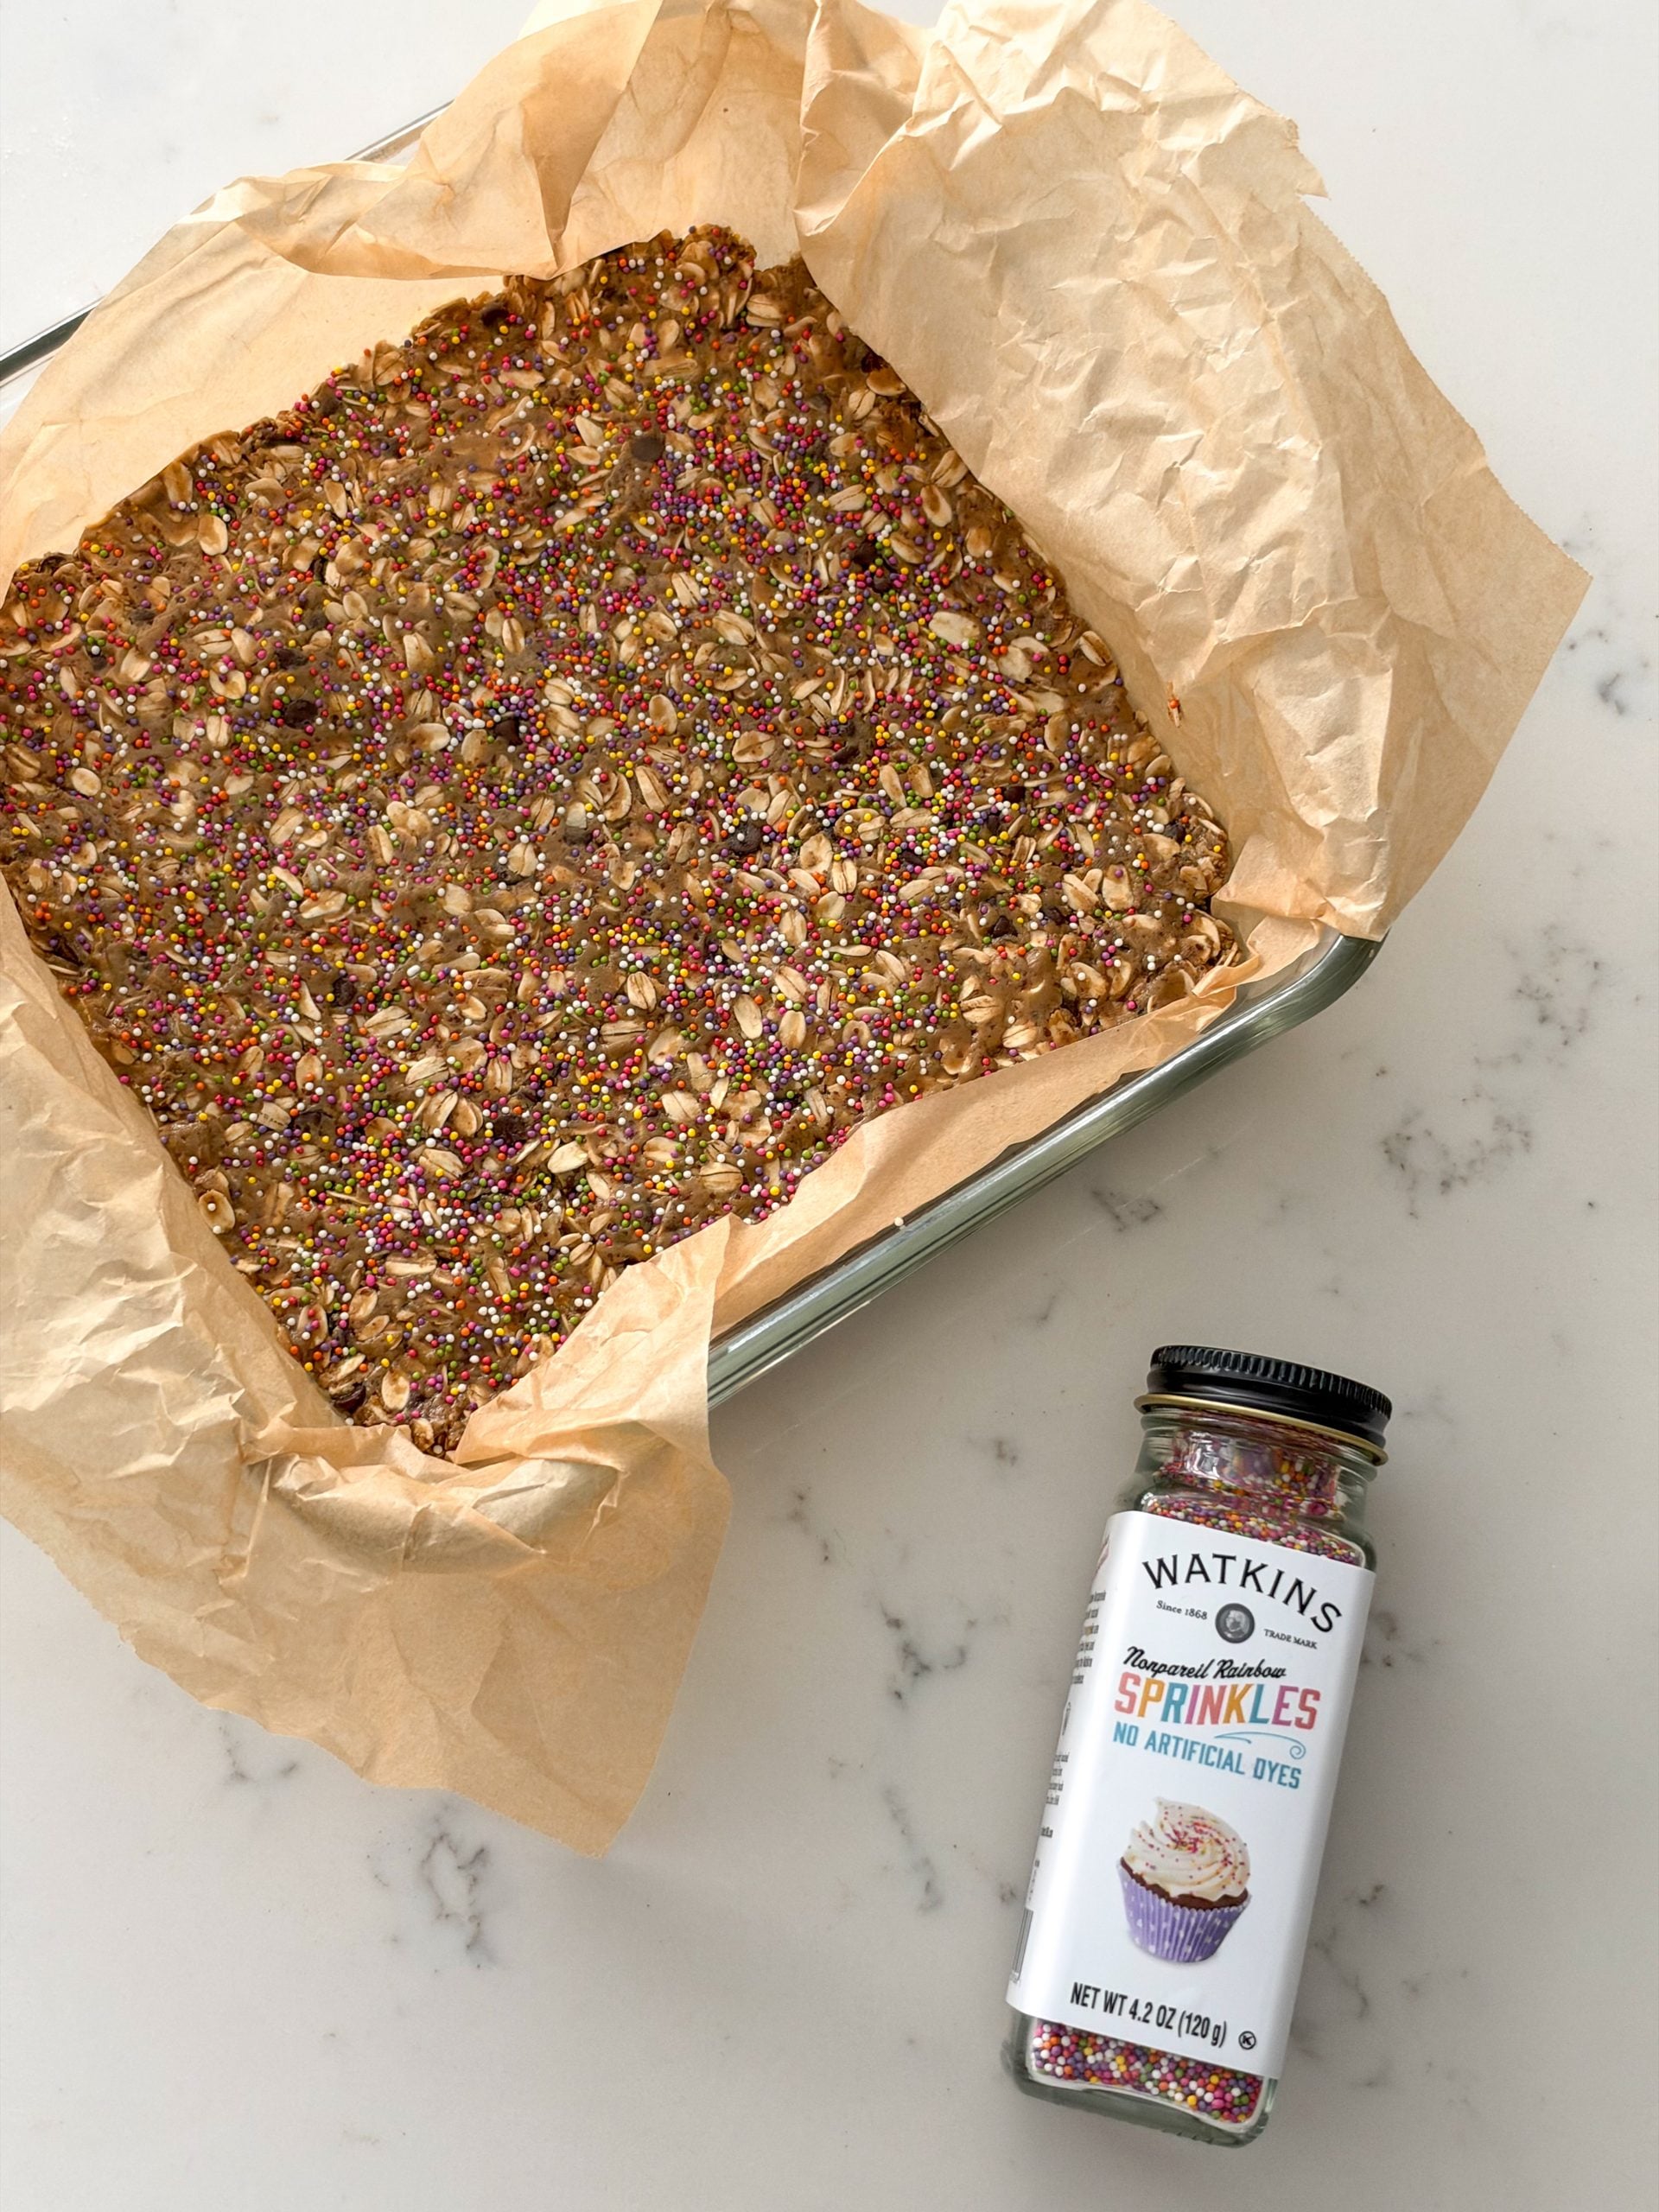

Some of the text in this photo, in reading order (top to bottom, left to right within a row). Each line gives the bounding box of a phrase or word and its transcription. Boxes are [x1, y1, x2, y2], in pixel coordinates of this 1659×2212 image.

[1142, 1553, 1342, 1633] WATKINS
[1156, 1600, 1208, 1620] Since 1868
[1123, 1646, 1215, 1679] Nonpareil
[1213, 1659, 1287, 1679] Rainbow
[1263, 1629, 1318, 1649] TRADE MARK
[1114, 1671, 1320, 1730] SPRINKLES
[1113, 1721, 1302, 1789] NO ARTIFICIAL DYES
[1071, 1982, 1227, 2048] NET WT 4.2 OZ (120 g)
